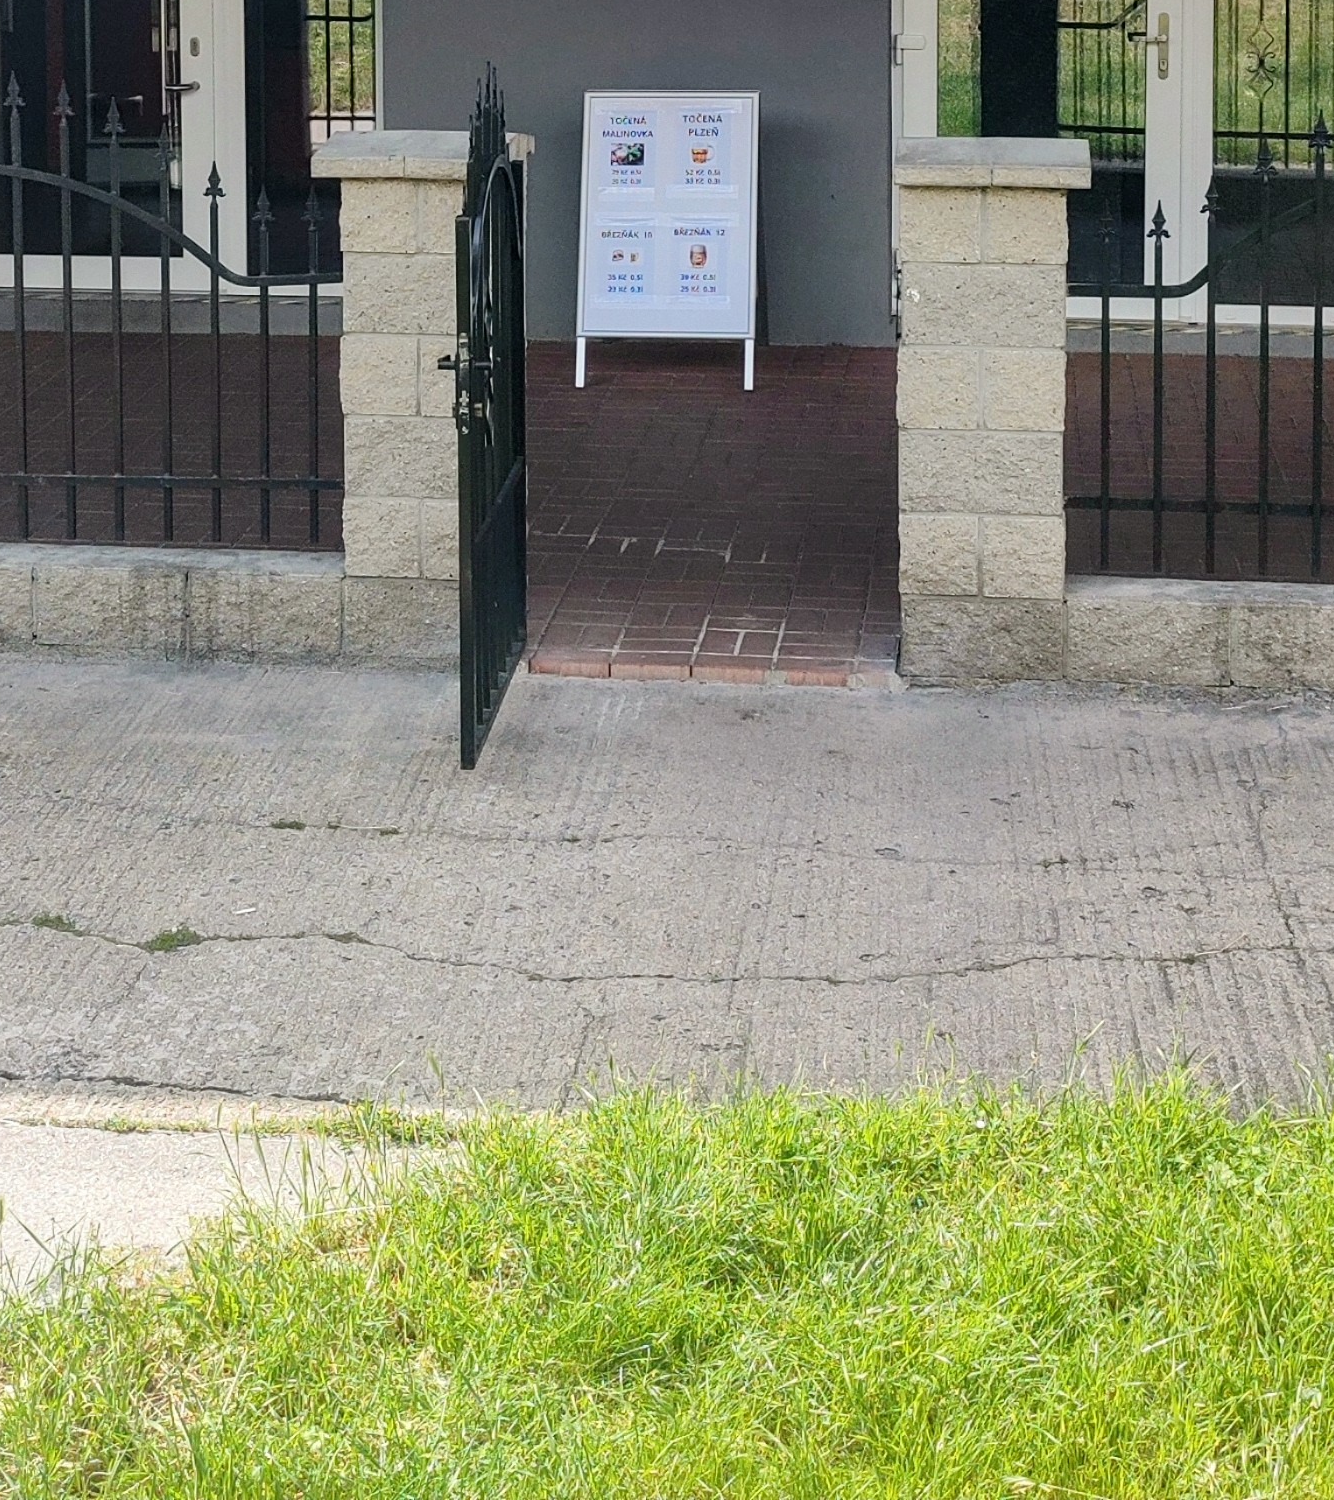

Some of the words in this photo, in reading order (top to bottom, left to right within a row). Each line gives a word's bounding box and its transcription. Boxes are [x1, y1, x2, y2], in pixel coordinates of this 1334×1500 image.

[610, 115, 647, 125] TOČENÁ
[683, 113, 723, 123] TOČENÁ
[602, 130, 654, 138] MALINOVKA
[688, 126, 719, 137] PLZEŇ
